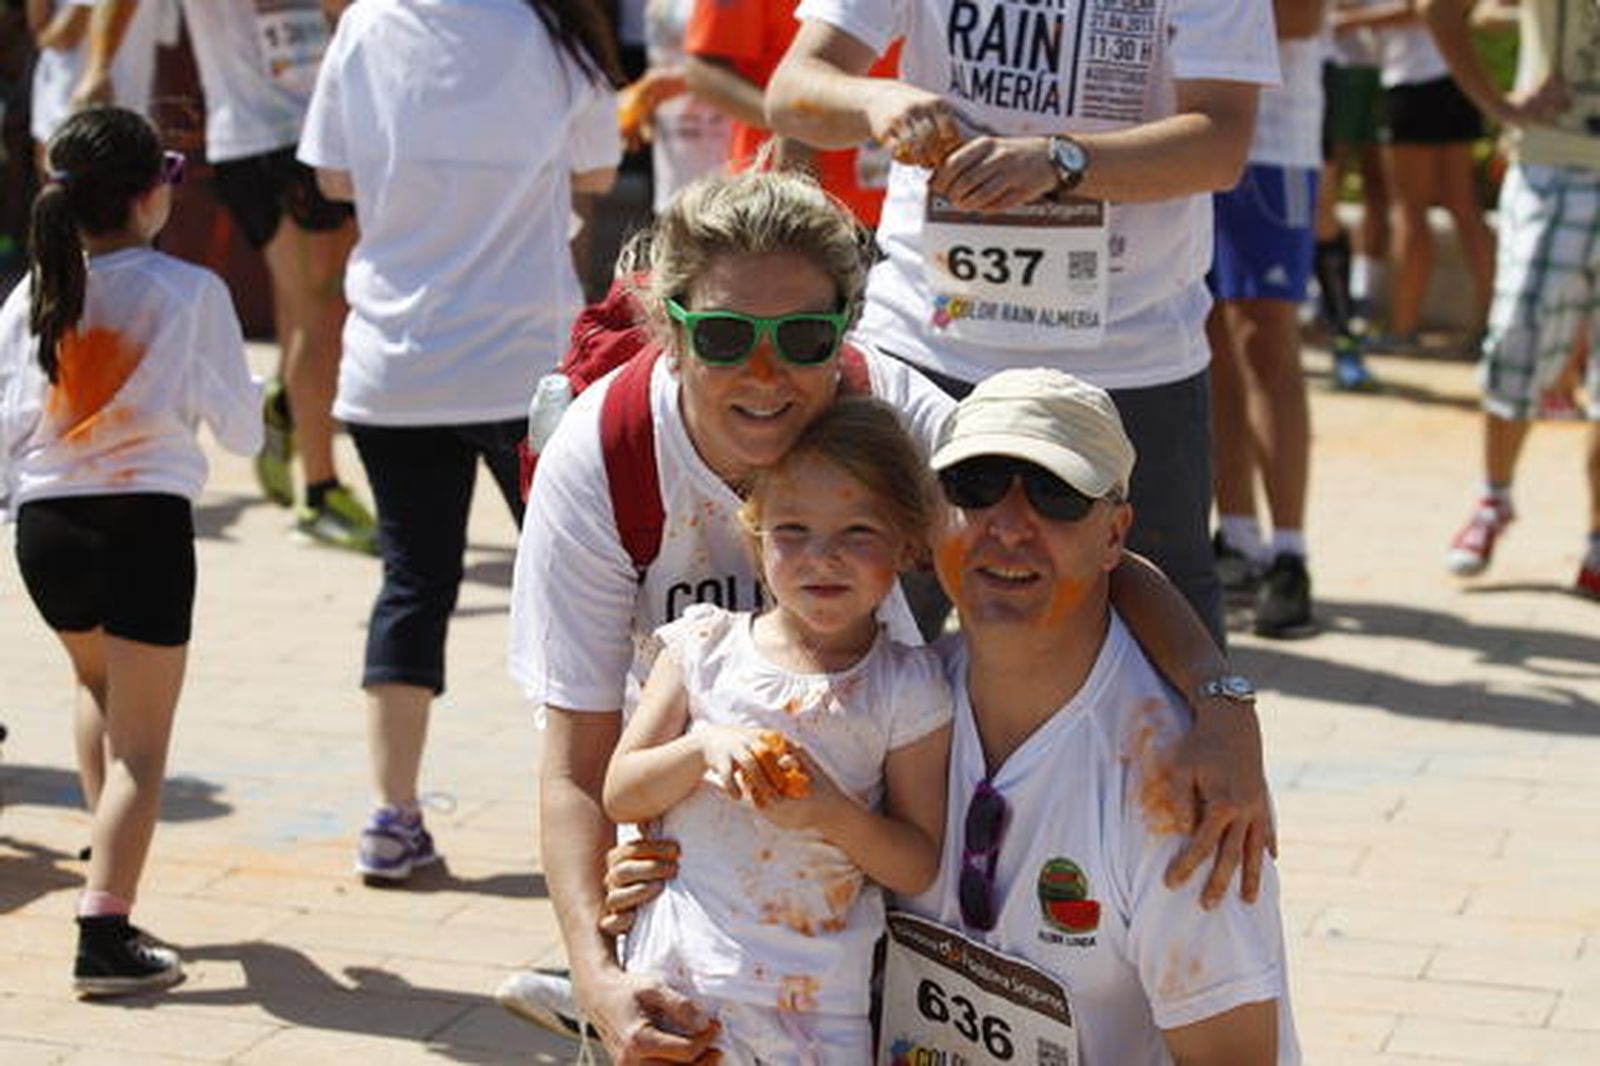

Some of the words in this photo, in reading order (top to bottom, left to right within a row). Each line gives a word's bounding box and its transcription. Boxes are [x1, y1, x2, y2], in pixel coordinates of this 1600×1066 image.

[948, 0, 1065, 73] RAIN
[949, 61, 1061, 116] ALMERÍA
[947, 246, 1045, 287] 637
[917, 979, 1015, 1061] 636
